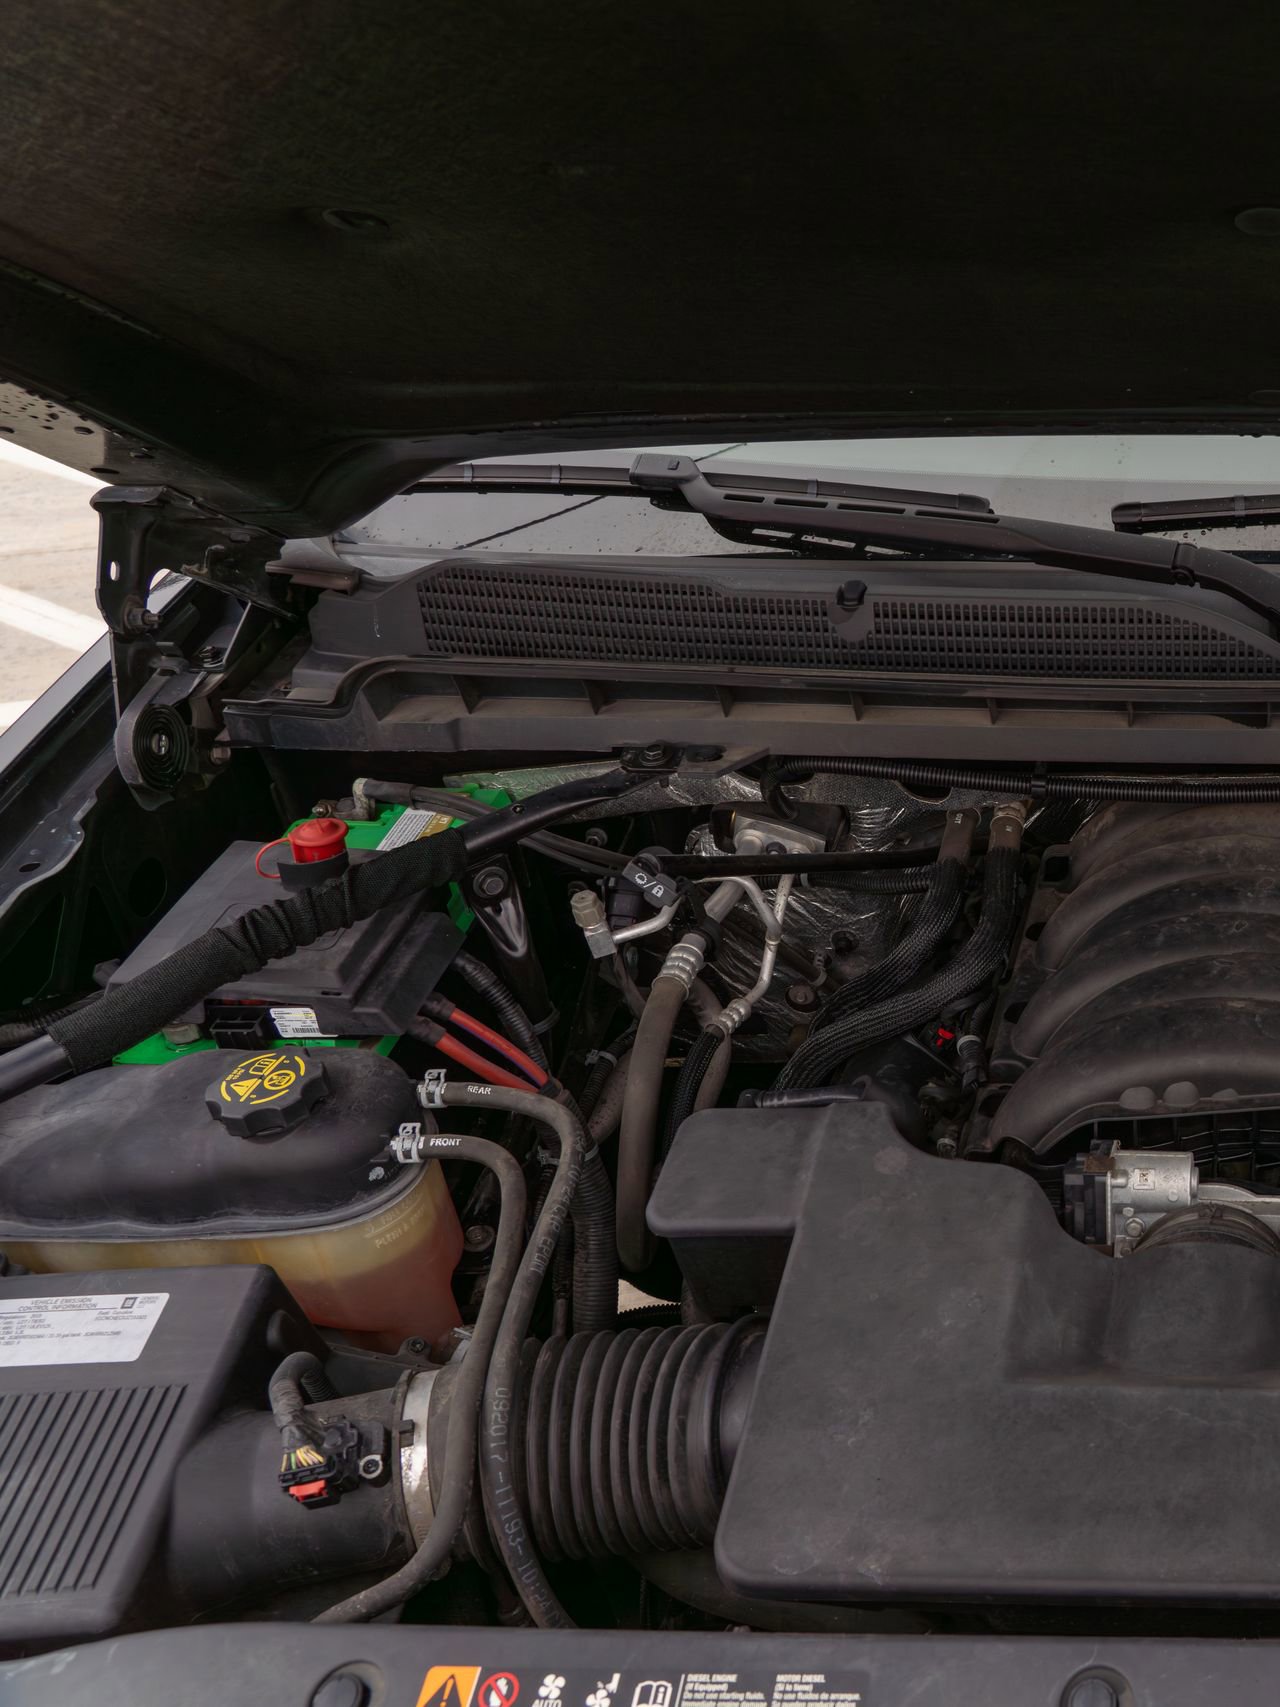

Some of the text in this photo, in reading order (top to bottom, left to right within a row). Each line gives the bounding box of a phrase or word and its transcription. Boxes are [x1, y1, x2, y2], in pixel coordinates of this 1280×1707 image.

[467, 1085, 491, 1095] REAR
[429, 1138, 461, 1147] FRONT
[31, 1297, 93, 1306] VEHICLE EMISSION
[18, 1302, 98, 1312] CONTROL INFORMATION
[687, 1674, 738, 1682] DIESEL ENGINE
[532, 1699, 562, 1707] AUTO
